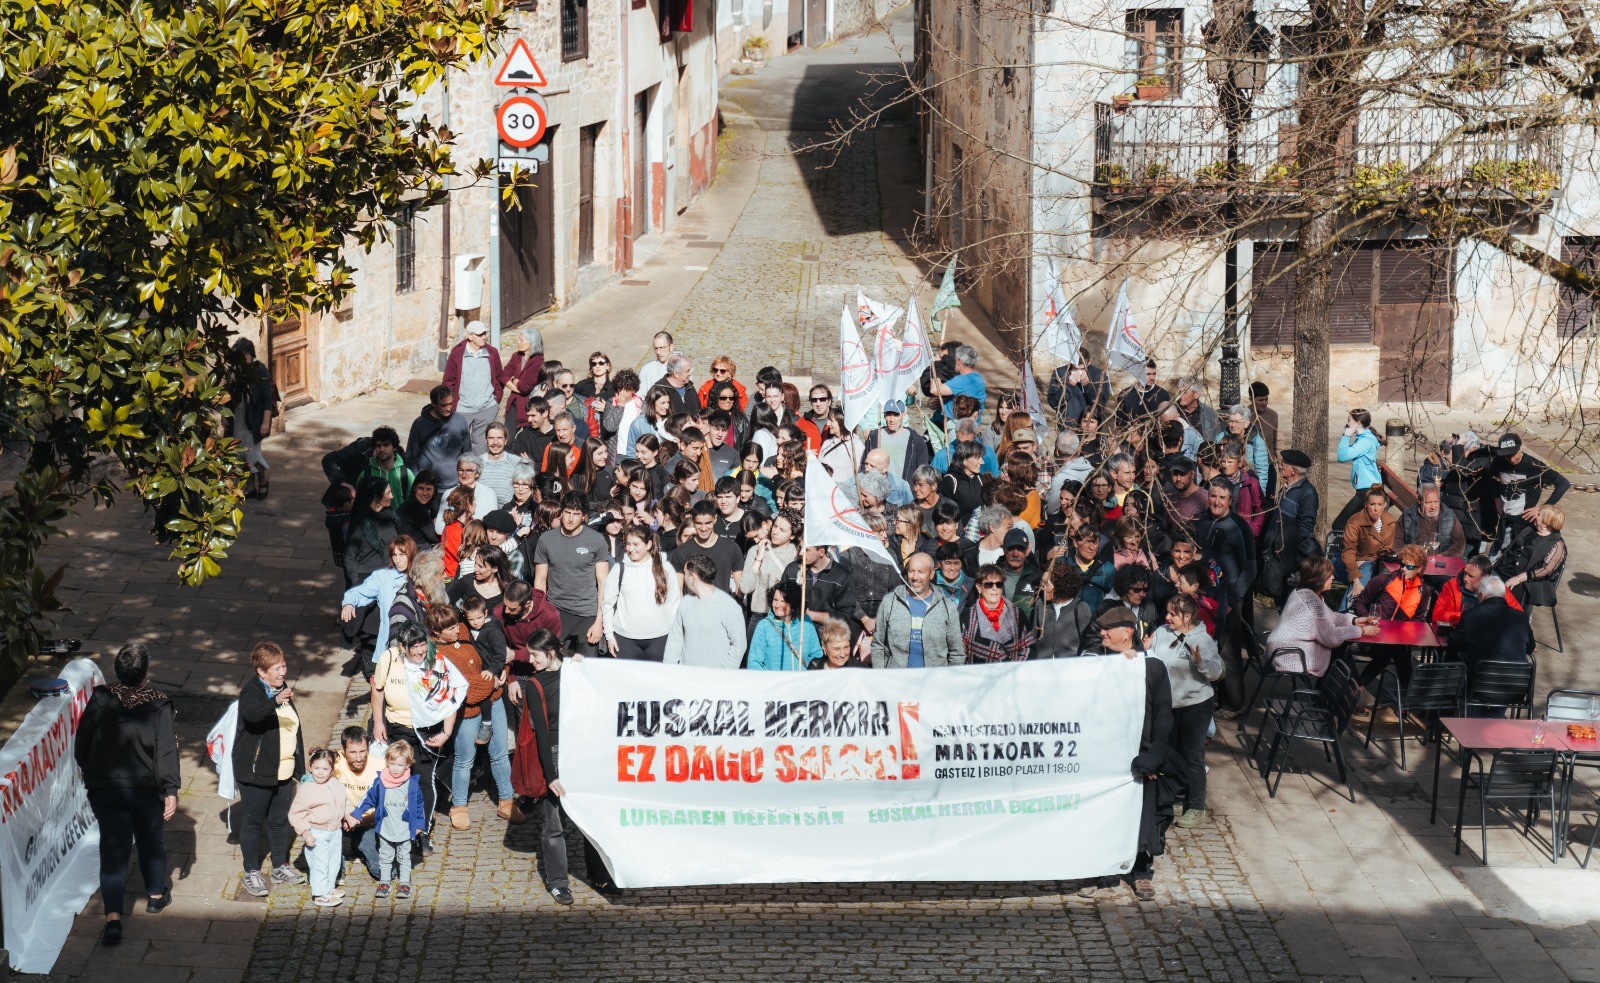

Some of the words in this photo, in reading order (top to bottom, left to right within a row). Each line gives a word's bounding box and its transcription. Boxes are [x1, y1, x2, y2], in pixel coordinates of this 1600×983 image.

[507, 113, 535, 129] 30
[833, 519, 865, 538] ARAMAIXO
[616, 698, 755, 737] EUSKAL
[764, 699, 892, 738] HERRIA
[1018, 721, 1081, 736] NAZIONALA
[935, 741, 1045, 762] MARTXOAK
[1053, 740, 1078, 758] 22
[617, 744, 657, 783] EZ
[664, 744, 764, 783] DAGO
[934, 767, 976, 779] GASTEIZ
[983, 765, 1014, 778] BILBO
[1015, 764, 1045, 775] PLAZA
[1053, 762, 1081, 774] 18:00
[620, 808, 726, 827] LURRAREN
[733, 805, 844, 827] DEFENTSAN
[868, 802, 936, 824] EUSKAL
[938, 799, 1006, 818] HERRIA
